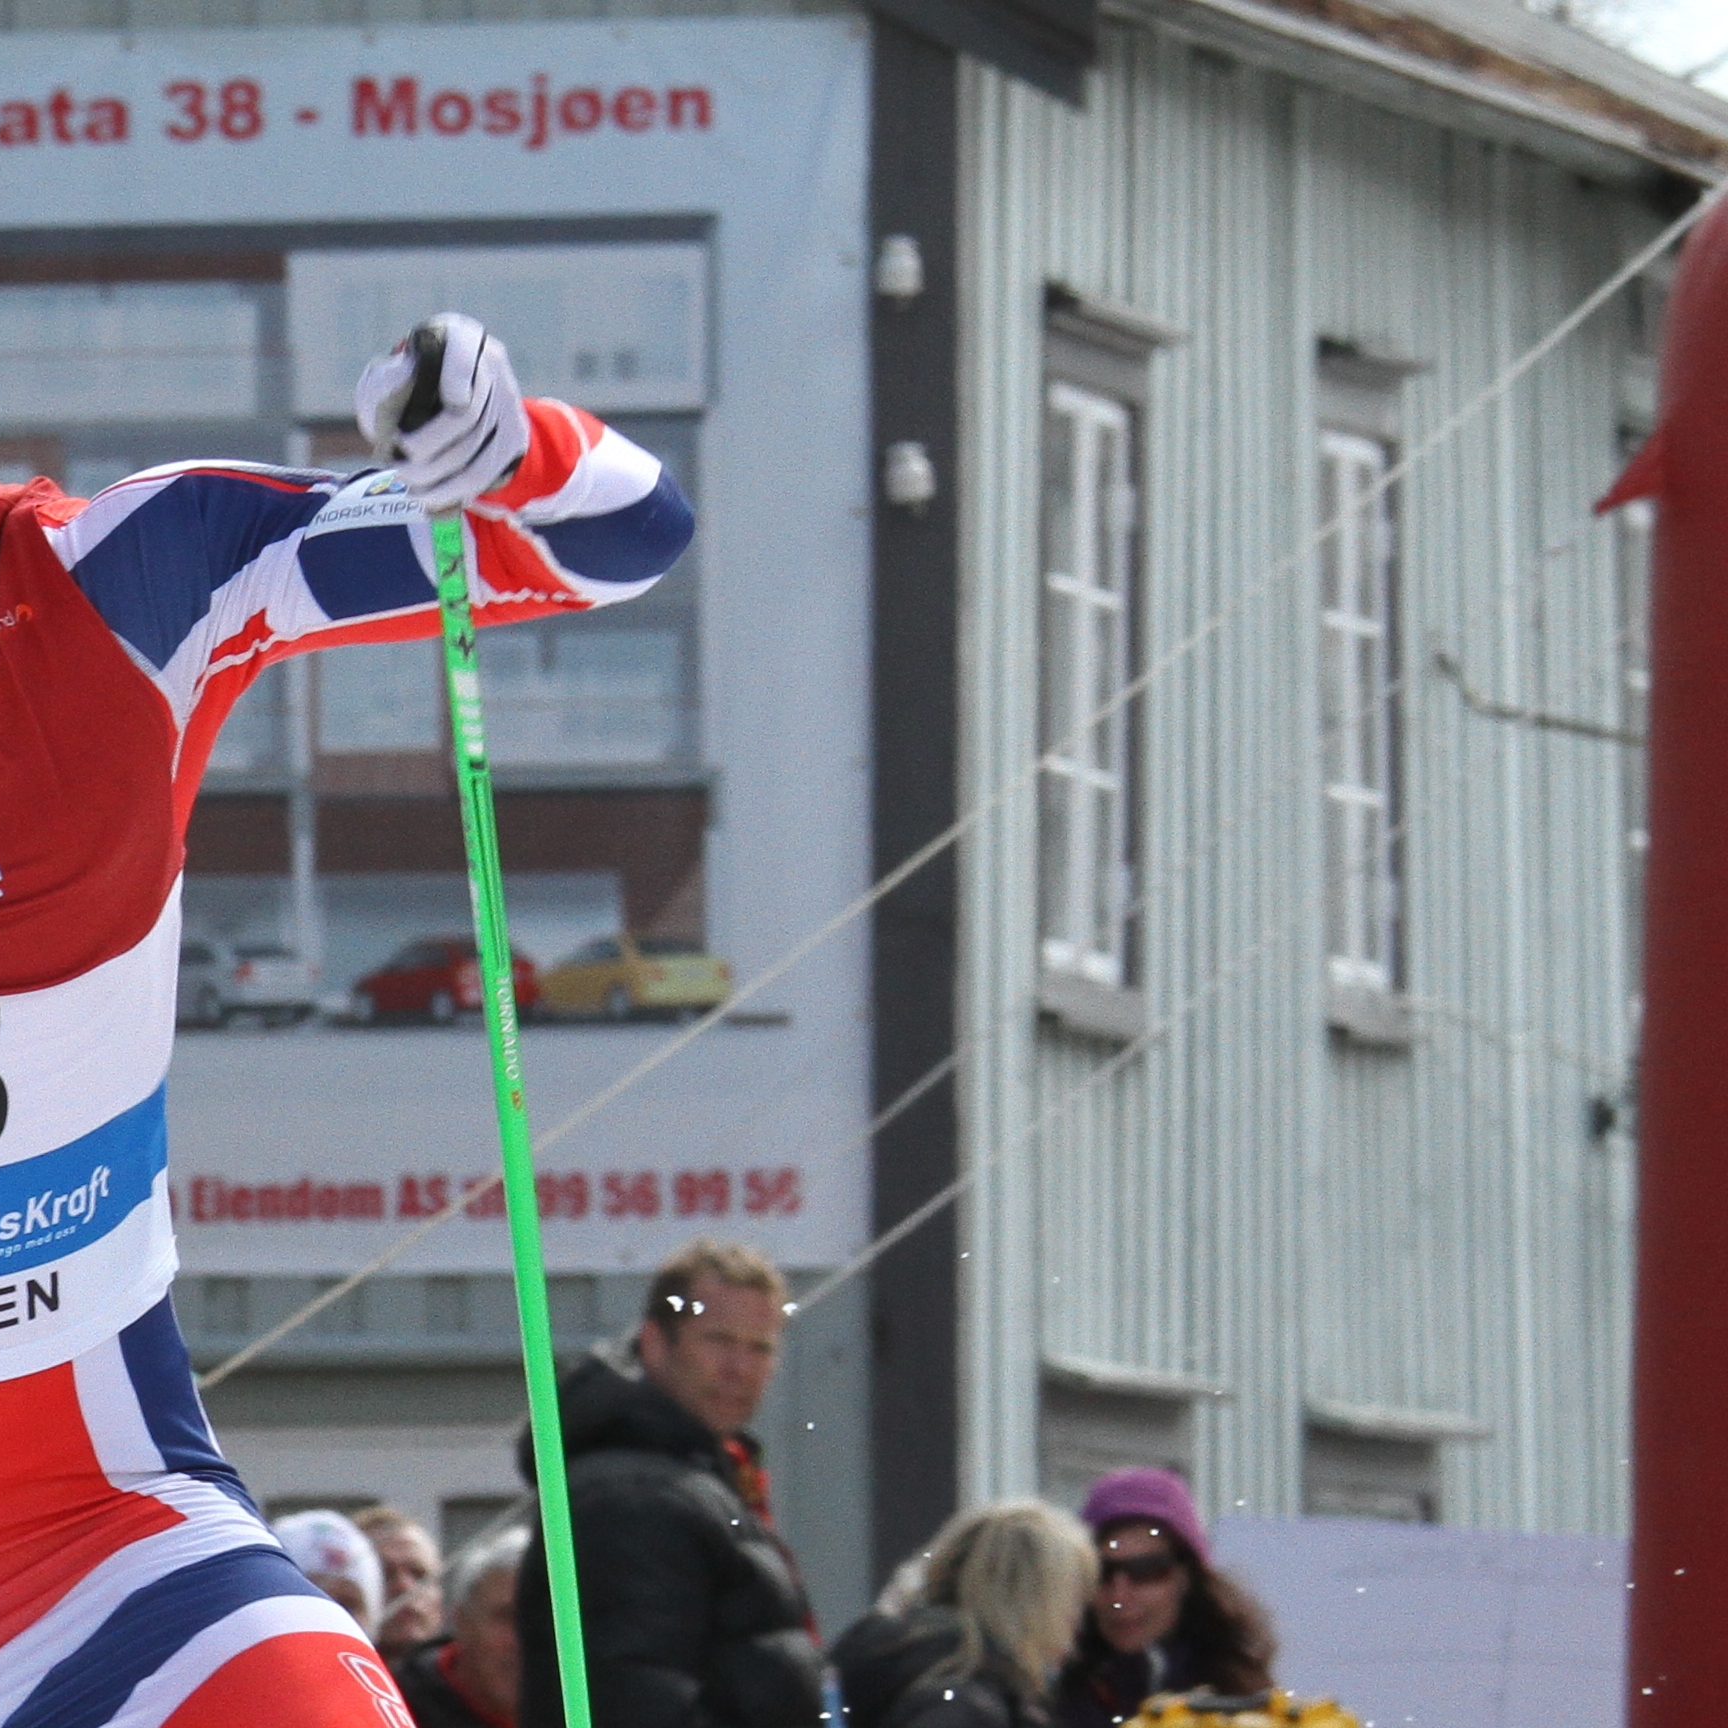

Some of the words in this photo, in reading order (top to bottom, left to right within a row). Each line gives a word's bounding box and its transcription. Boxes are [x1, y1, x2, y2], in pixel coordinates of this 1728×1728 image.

[163, 78, 266, 141] 38
[351, 71, 714, 151] Mosjøen
[314, 503, 375, 525] NORSK
[396, 1172, 451, 1220] AS
